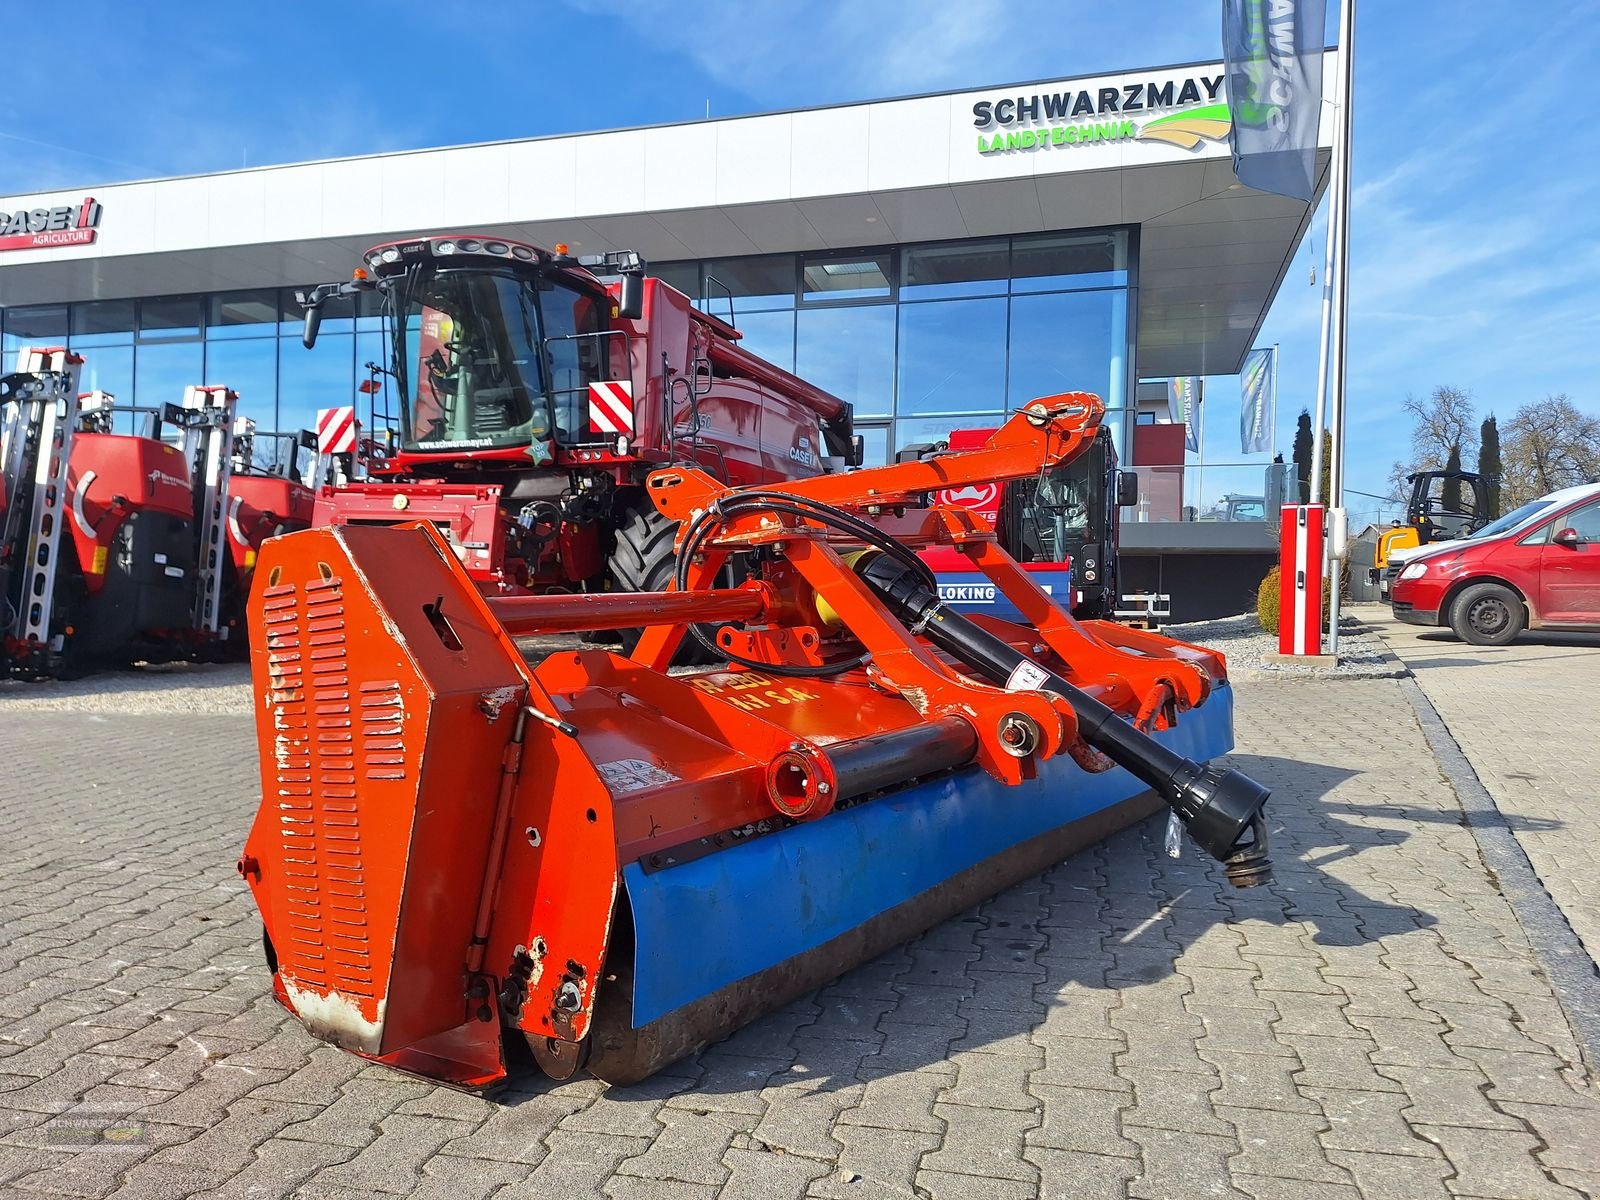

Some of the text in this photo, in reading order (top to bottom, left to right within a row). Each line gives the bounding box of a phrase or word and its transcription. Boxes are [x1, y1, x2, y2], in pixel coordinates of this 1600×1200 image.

[977, 119, 1136, 153] LANDTECHNIK
[32, 231, 89, 245] AGRICULTURE
[418, 437, 493, 449] www.schwarzmayr.at
[789, 446, 809, 464] CASE
